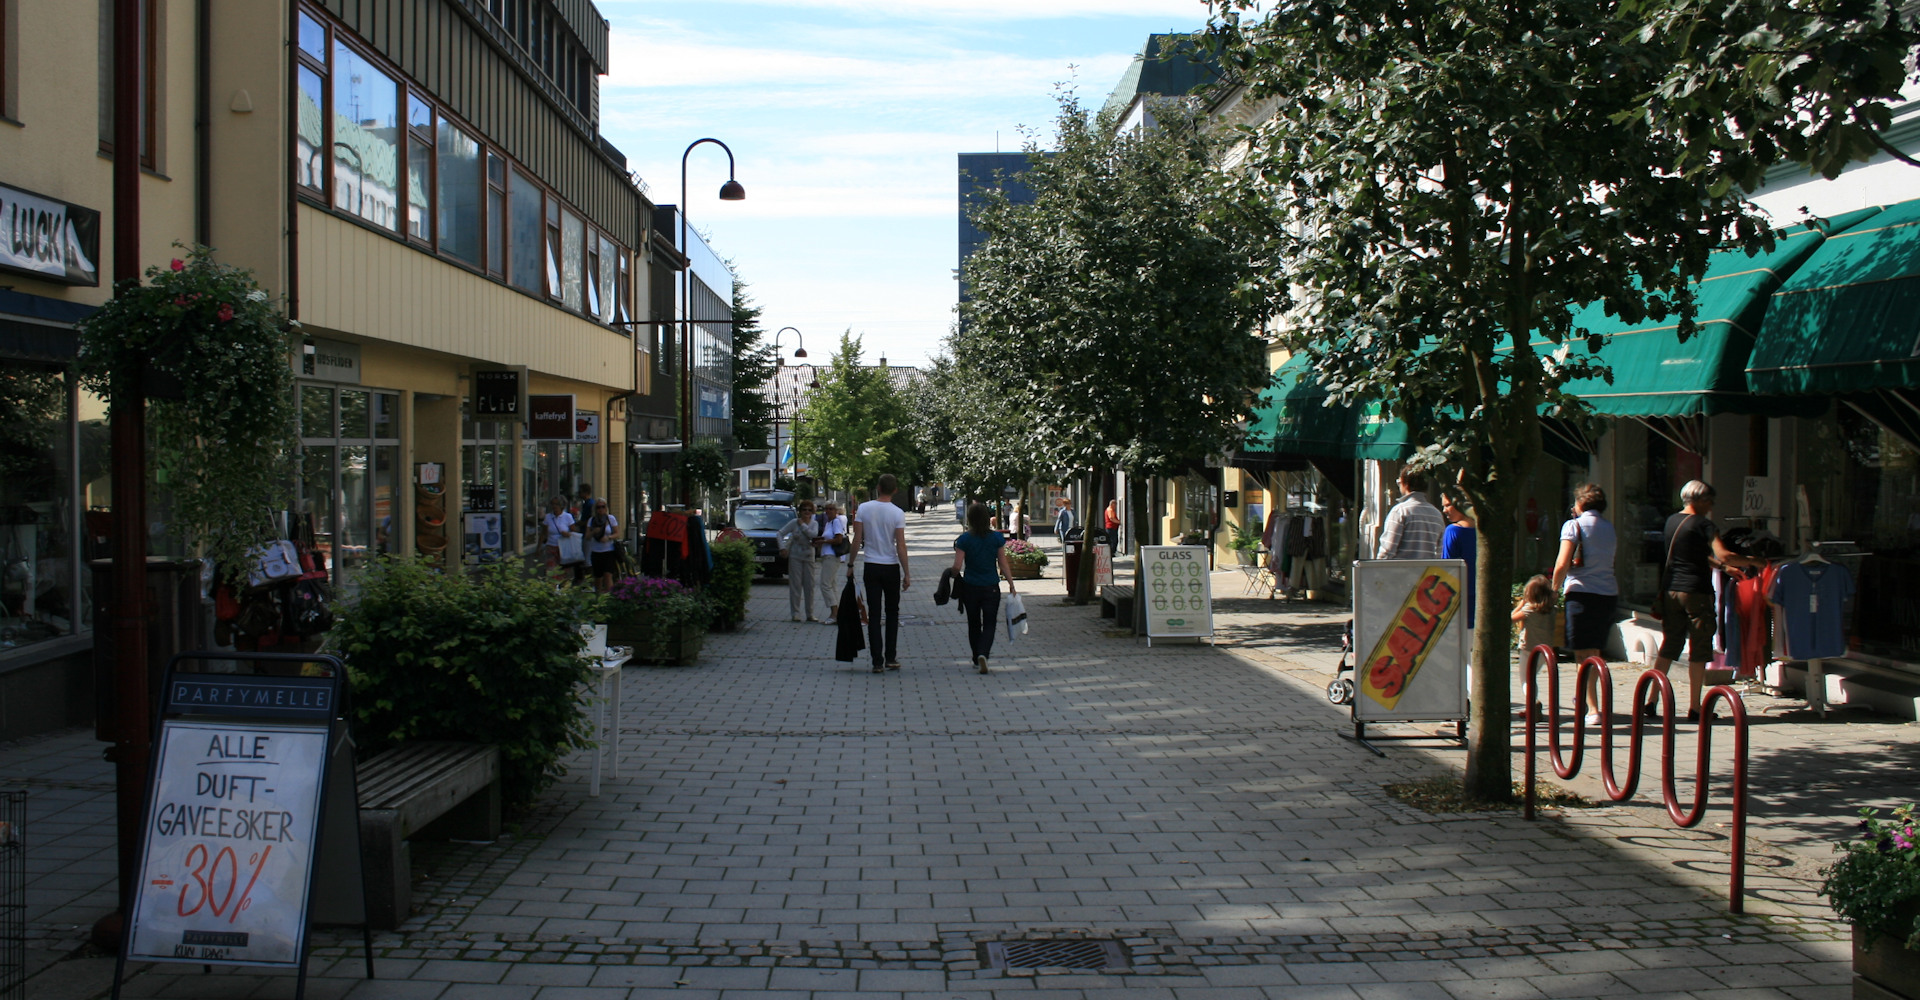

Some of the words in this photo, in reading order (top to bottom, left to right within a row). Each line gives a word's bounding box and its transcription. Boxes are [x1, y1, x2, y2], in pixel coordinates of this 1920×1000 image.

[12, 202, 61, 264] LUCK
[535, 411, 566, 421] kaffefryd
[1159, 551, 1192, 560] GLASS
[1369, 574, 1457, 699] SALG
[178, 686, 327, 707] PARFYMELLE
[207, 734, 270, 759] ALLE
[197, 772, 275, 803] DUFT-
[157, 803, 294, 843] GAVEESKER
